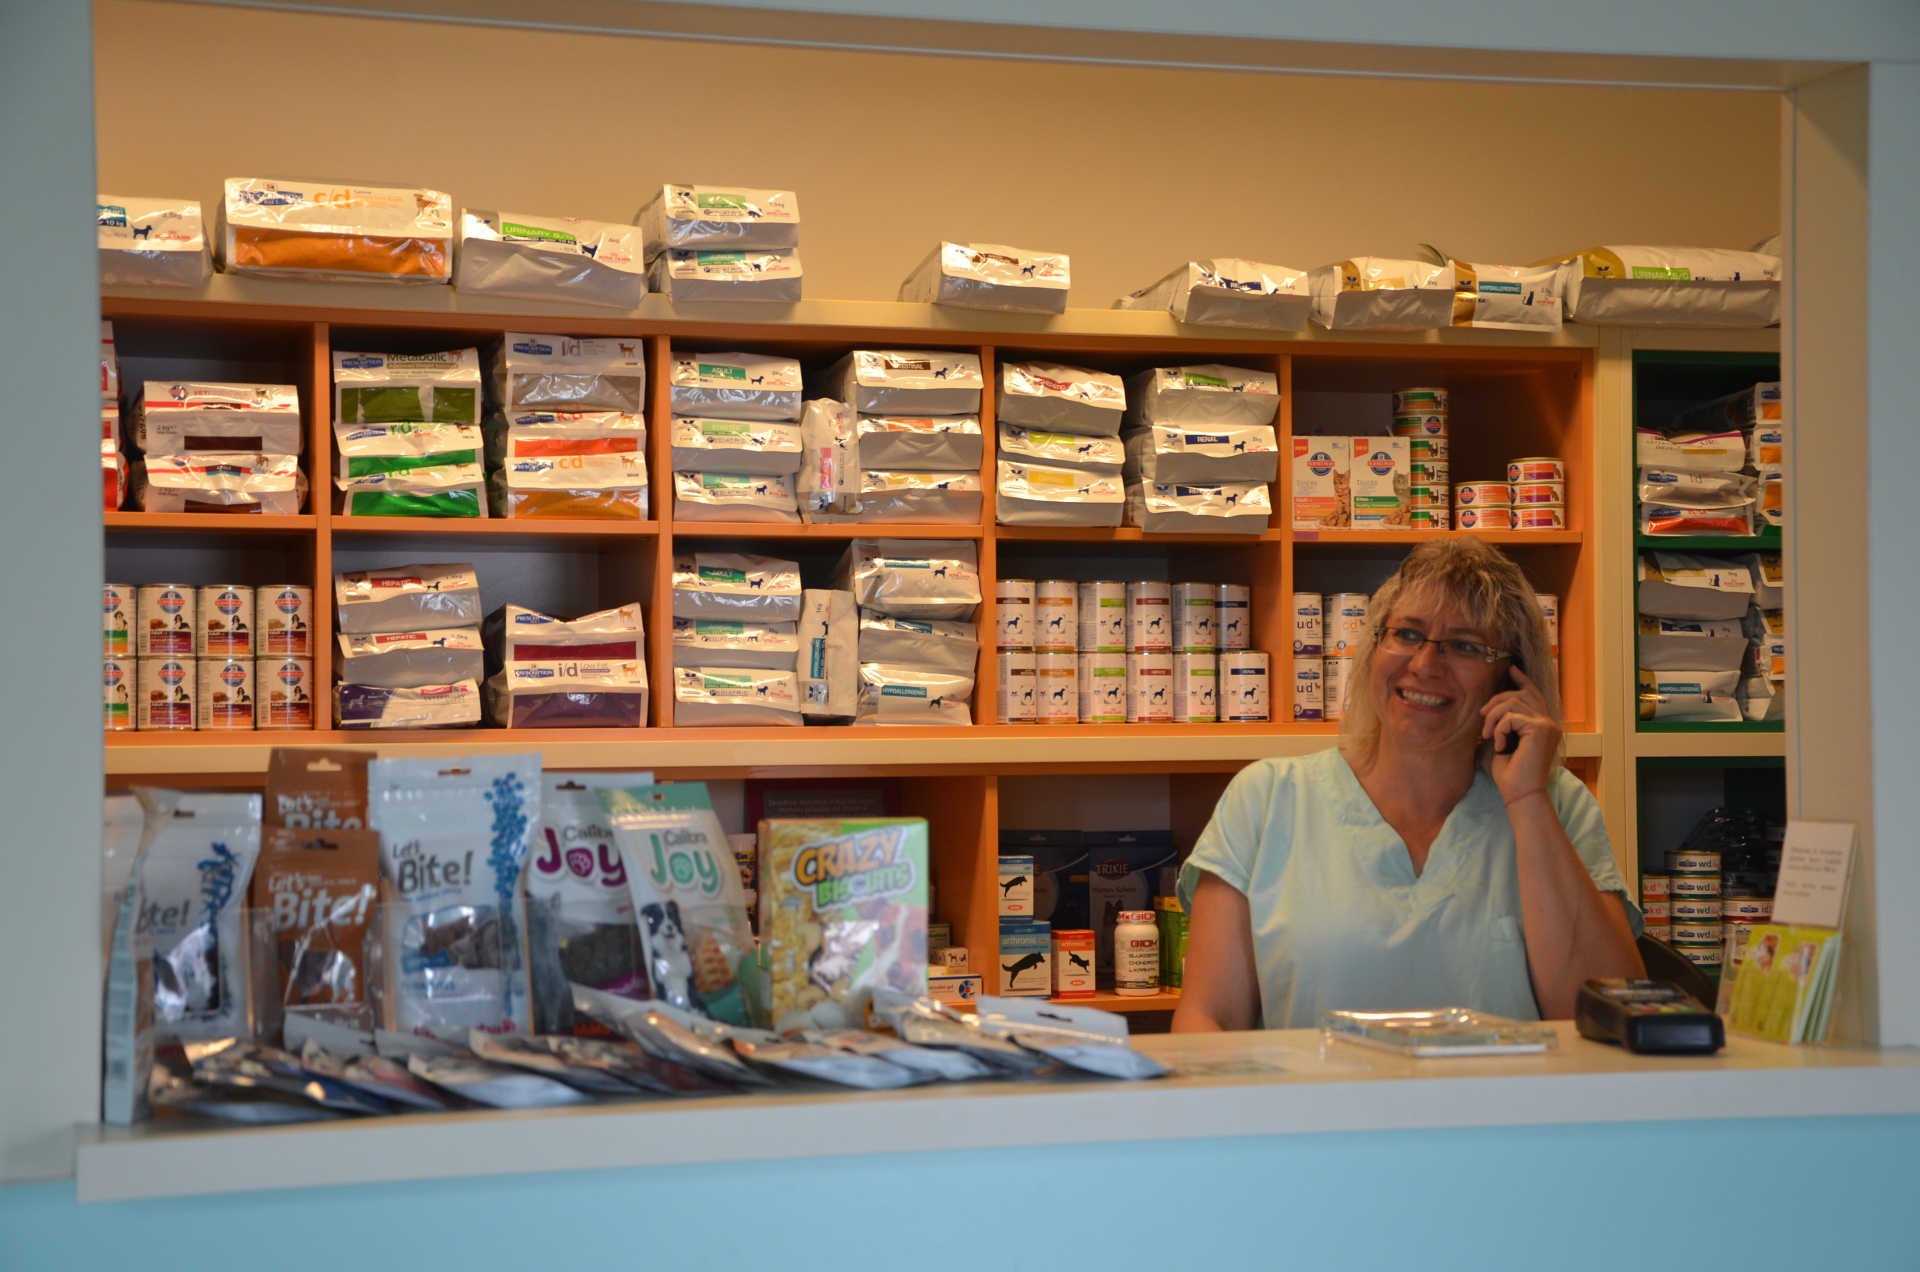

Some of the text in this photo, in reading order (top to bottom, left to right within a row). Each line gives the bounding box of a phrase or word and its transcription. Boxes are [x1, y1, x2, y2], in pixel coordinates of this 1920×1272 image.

[313, 188, 351, 210] c/d
[505, 226, 573, 241] URINARY S/O
[1634, 270, 1669, 279] URINARY
[1479, 284, 1521, 293] HYPOALLERGENIC
[386, 353, 447, 362] Metabolic
[558, 454, 584, 469] c/d
[558, 663, 579, 677] i/d
[882, 687, 926, 696] HYPOALLERGENIC
[663, 828, 708, 845] Calibra
[650, 833, 719, 894] Joy
[796, 830, 900, 885] CRAZY
[398, 850, 474, 894] Bite!
[1095, 863, 1129, 875] TRIXIE
[271, 883, 376, 933] Bite!
[1001, 937, 1037, 945] arthronis
